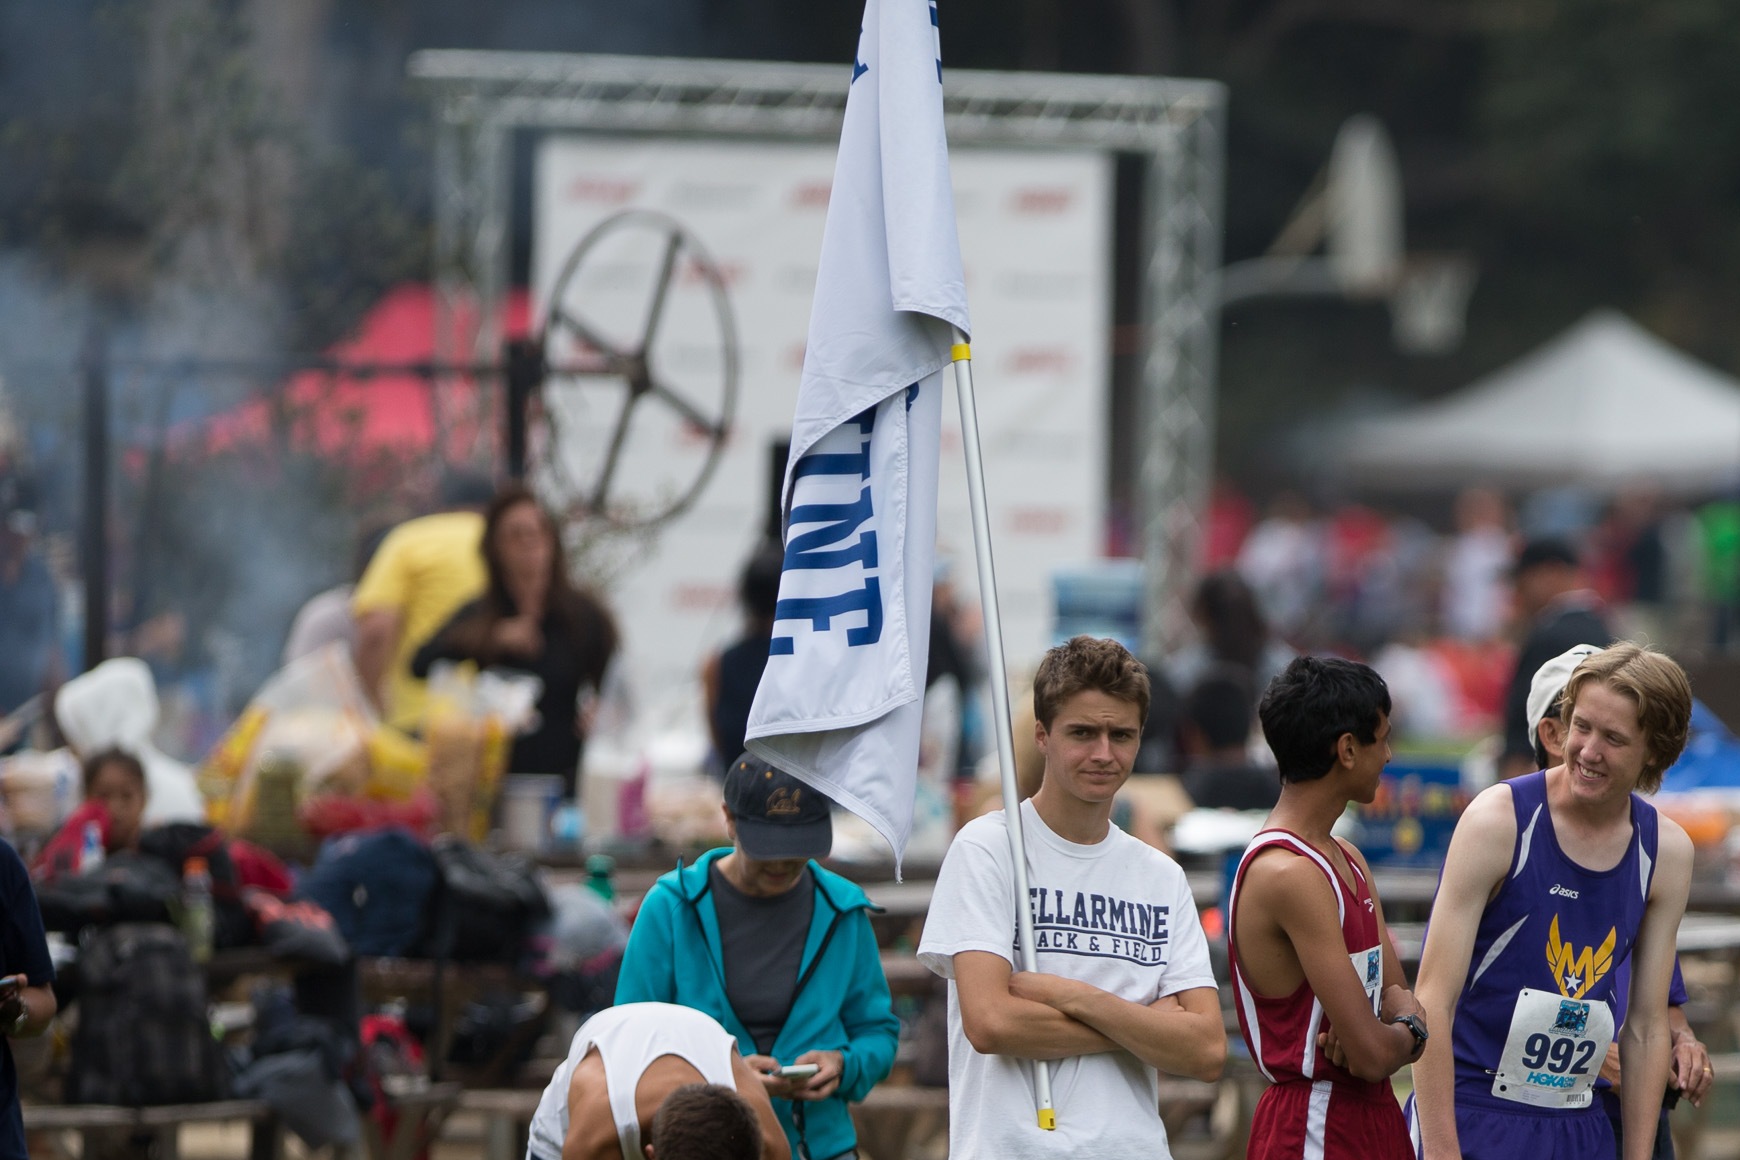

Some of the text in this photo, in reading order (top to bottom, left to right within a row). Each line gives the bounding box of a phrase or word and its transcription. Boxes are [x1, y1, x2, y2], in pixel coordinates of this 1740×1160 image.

[1029, 887, 1170, 940] ELLARMINE
[1089, 936, 1100, 952] &
[1112, 938, 1162, 962] FIELD
[1521, 1032, 1597, 1075] 992
[1526, 1071, 1565, 1088] HOKA
